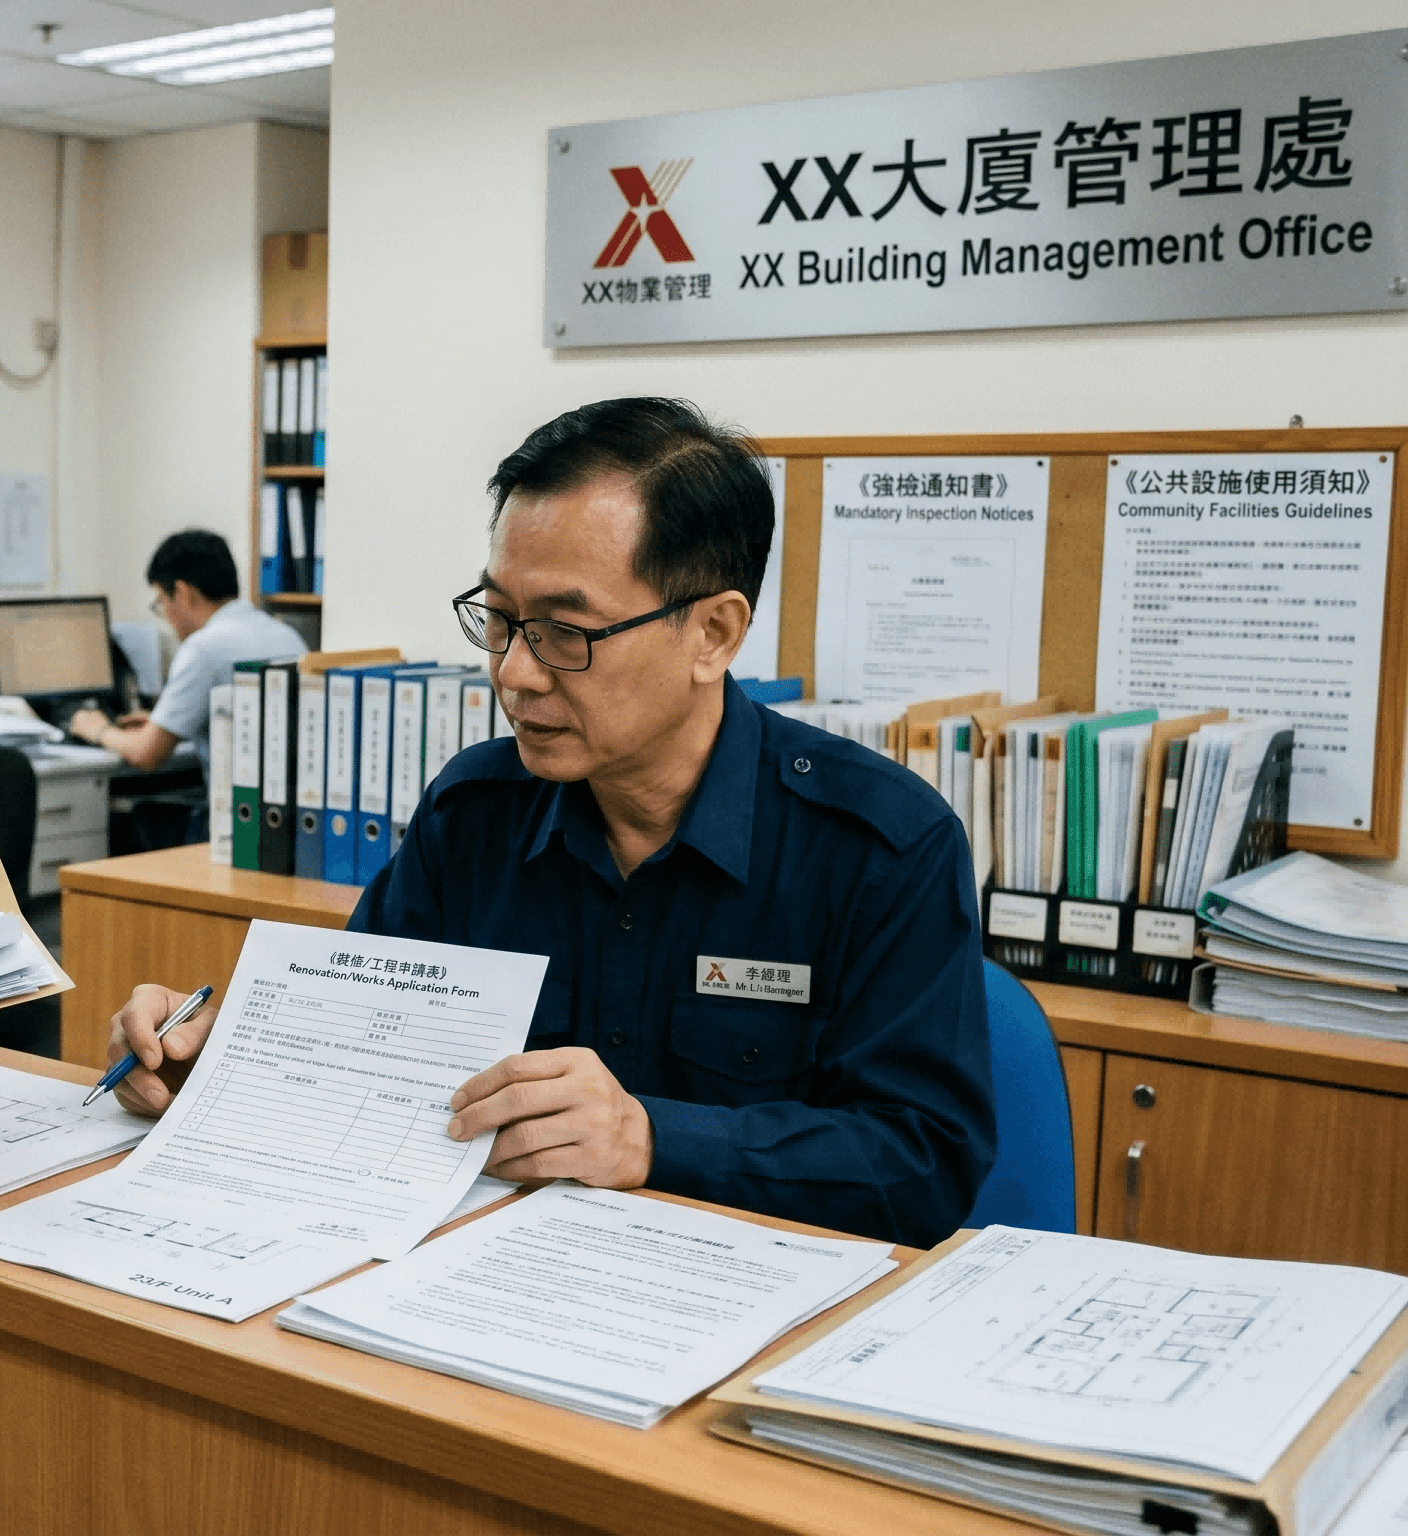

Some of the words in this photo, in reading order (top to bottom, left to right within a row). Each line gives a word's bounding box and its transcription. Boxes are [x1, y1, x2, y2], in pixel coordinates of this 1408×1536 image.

[757, 93, 1355, 225] XX大廈管理處
[739, 252, 785, 289] XX
[798, 244, 948, 289] Building
[960, 221, 1226, 281] Management
[1238, 213, 1374, 261] Office
[580, 273, 711, 305] XX物業管理
[859, 472, 1009, 499] 《強檢通知書》
[1125, 468, 1371, 496] 《公共設施使用須知》
[834, 504, 902, 523] Mandatory
[906, 504, 977, 522] Inspection
[981, 505, 1035, 522] Notices
[1118, 502, 1205, 521] Community
[1209, 502, 1280, 518] Facilities
[1285, 502, 1373, 519] Guidelines
[288, 962, 385, 987] Renovation/Works
[387, 977, 449, 995] Application
[451, 986, 480, 999] Form
[128, 1273, 173, 1288] 23/F
[173, 1285, 215, 1300] Unit
[215, 1297, 233, 1306] A
